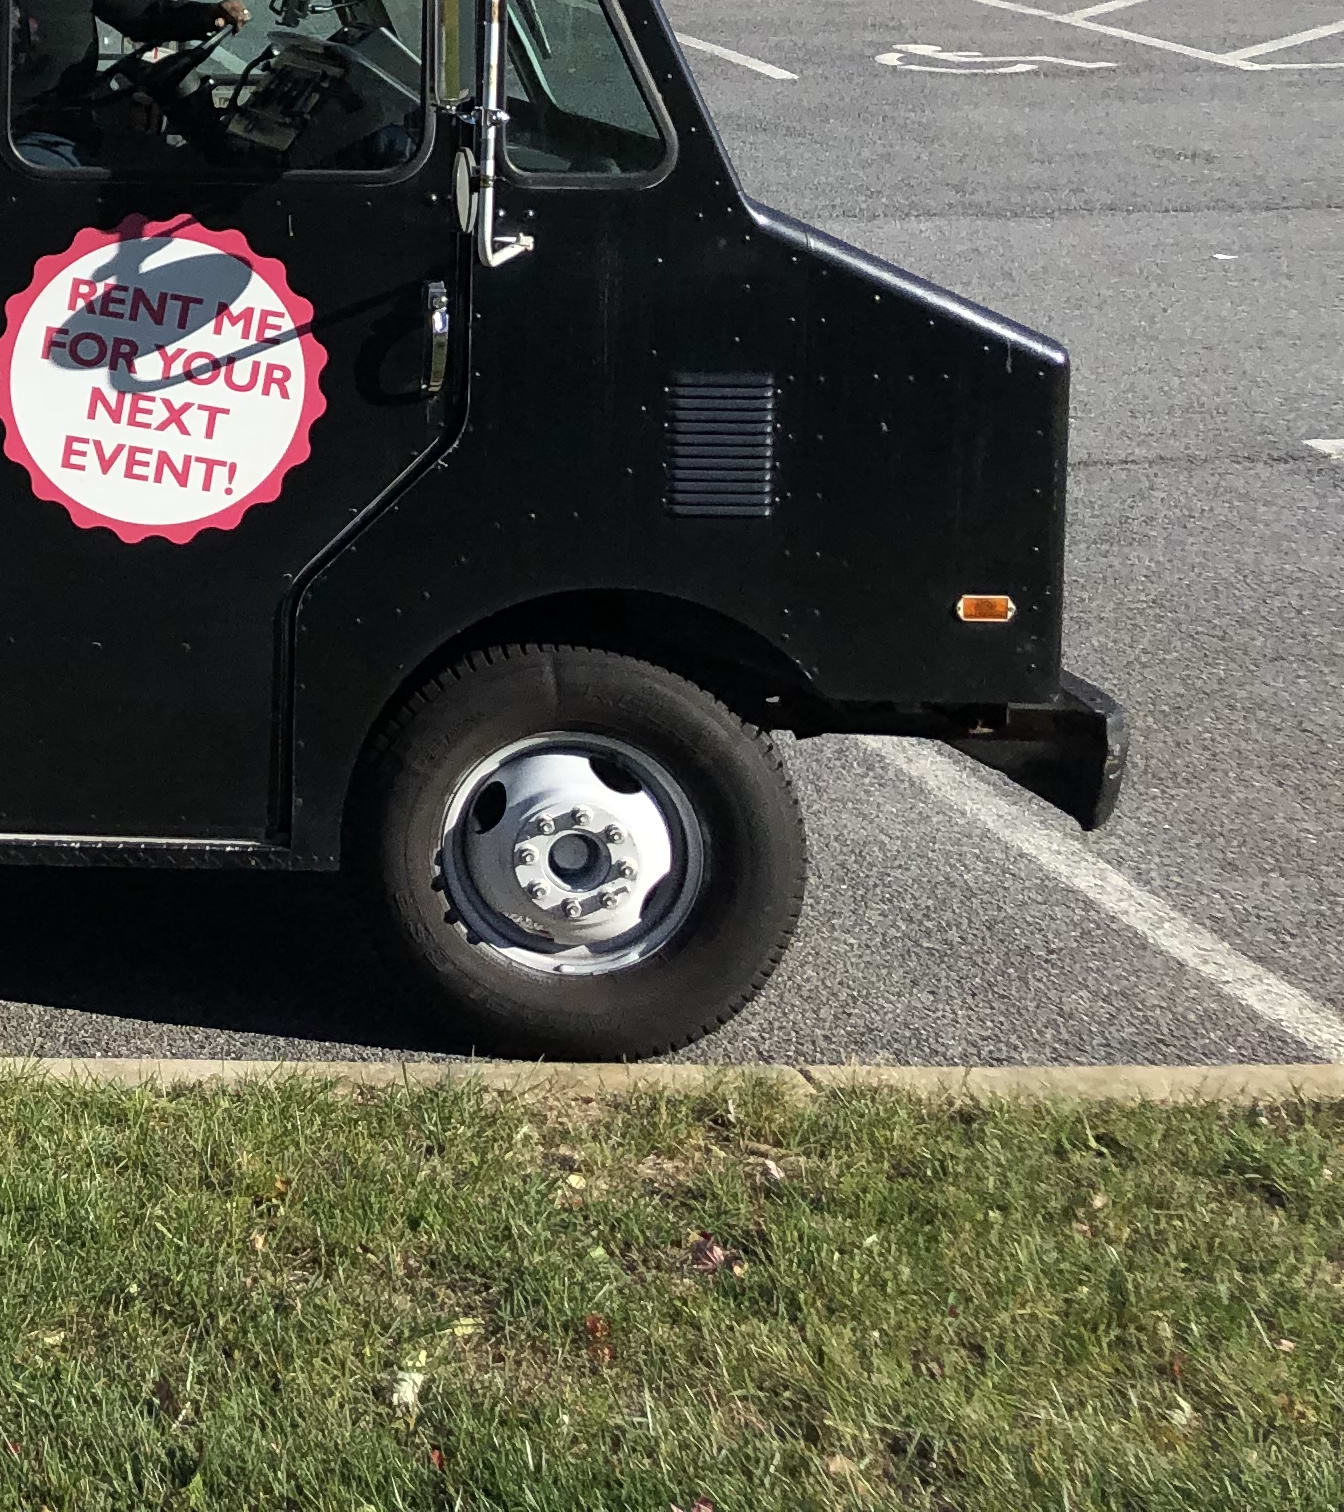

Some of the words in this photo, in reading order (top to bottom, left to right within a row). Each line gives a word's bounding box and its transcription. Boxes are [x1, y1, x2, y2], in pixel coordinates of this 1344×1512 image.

[67, 277, 204, 330] RENT
[213, 301, 285, 345] ME
[41, 326, 139, 375] FOR
[153, 343, 292, 400] YOUR
[86, 386, 231, 440] NEXT
[60, 434, 237, 496] EVENT!
